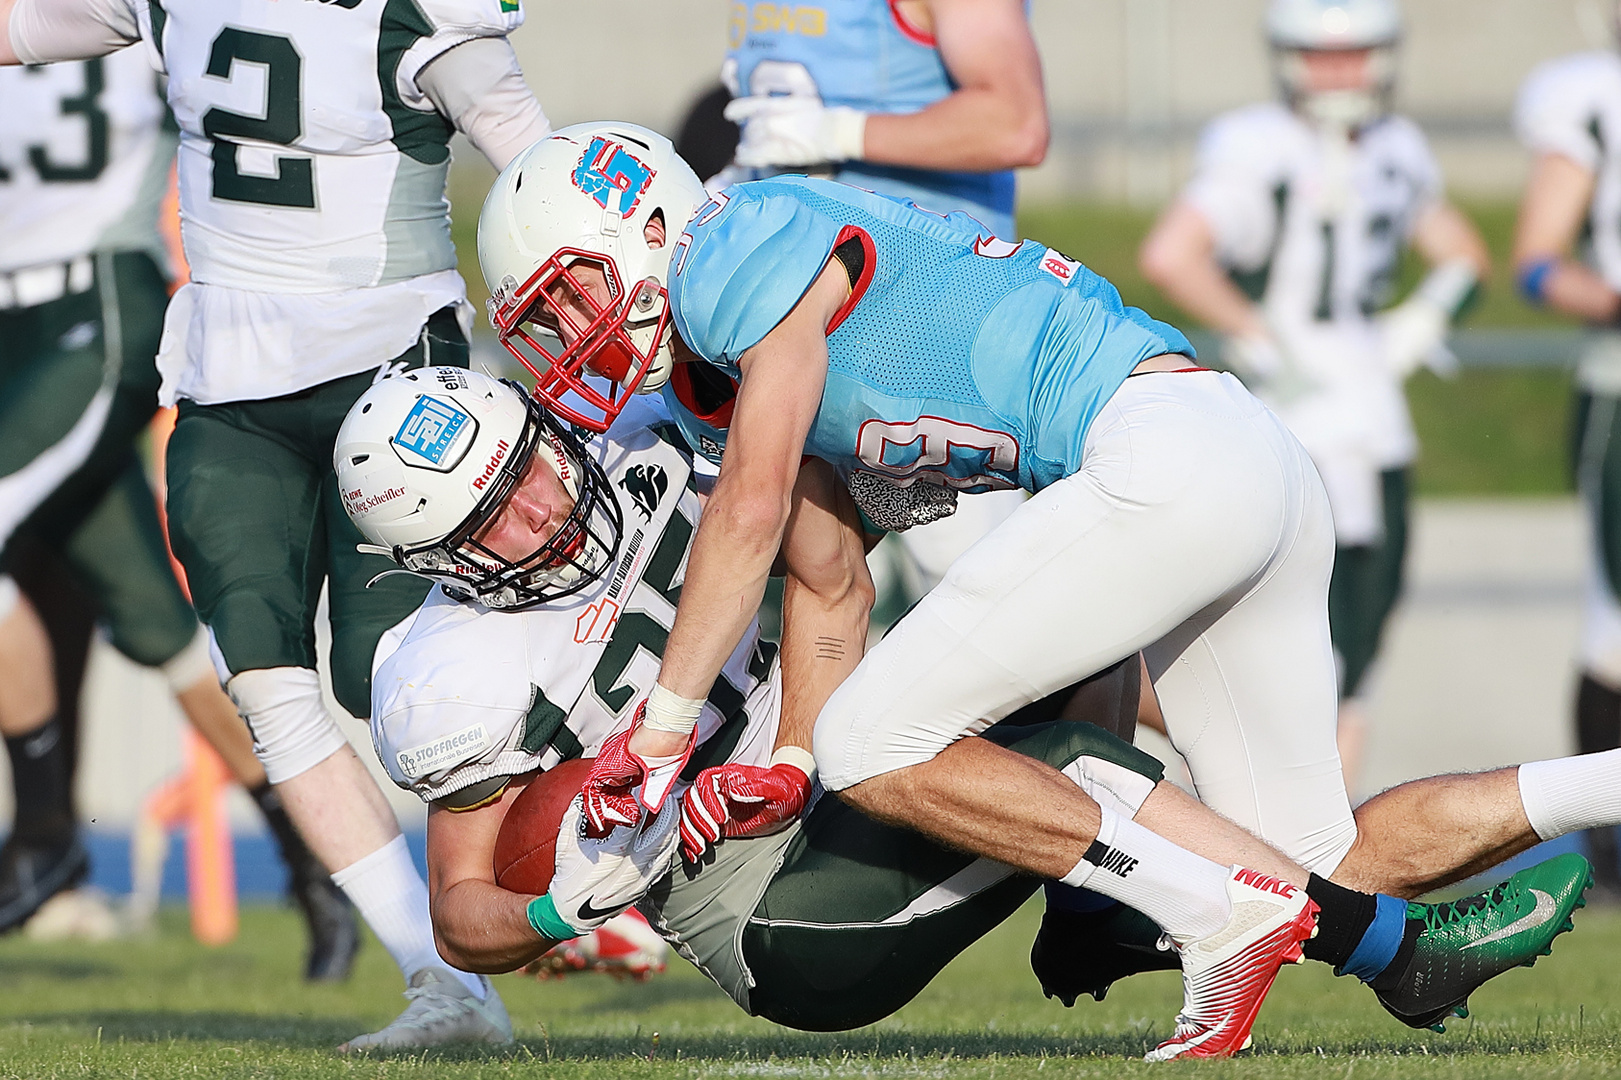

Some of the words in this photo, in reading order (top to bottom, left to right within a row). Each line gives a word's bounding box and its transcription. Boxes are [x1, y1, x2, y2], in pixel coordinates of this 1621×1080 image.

[0, 57, 109, 183] 3
[203, 25, 320, 212] 2
[432, 414, 464, 460] STREICH
[549, 433, 571, 480] Riddell
[472, 439, 510, 490] Riddell
[582, 546, 596, 567] iddell
[416, 726, 483, 762] STOFFREGEN
[1100, 848, 1139, 878] NIKE
[1233, 868, 1298, 899] NIKE
